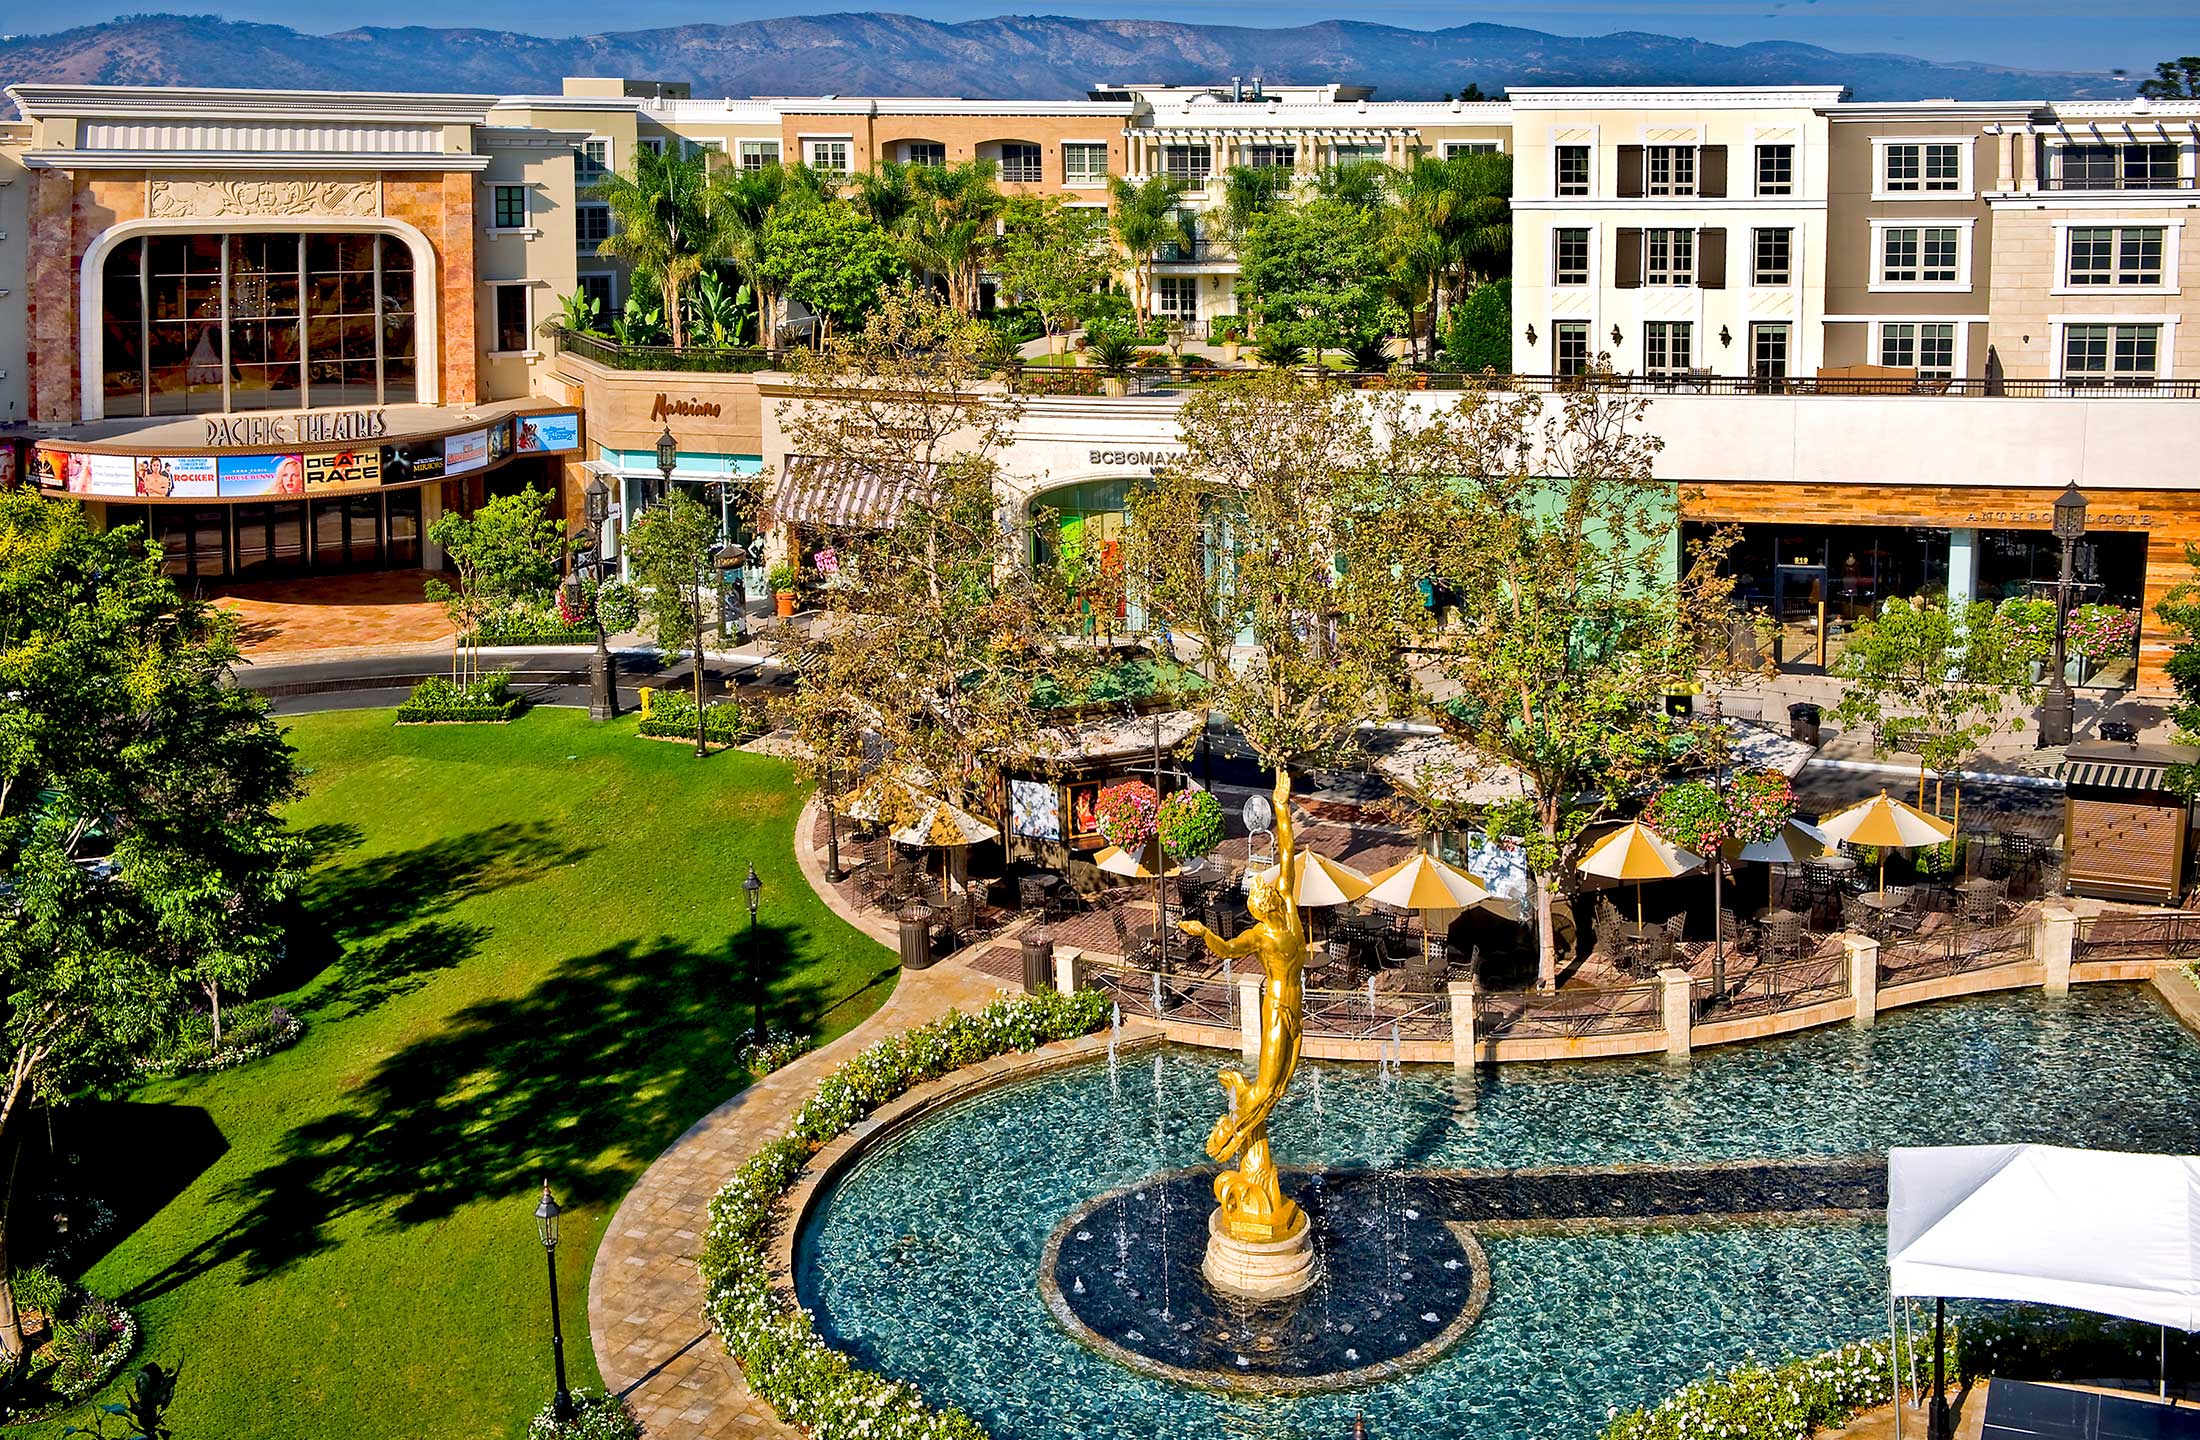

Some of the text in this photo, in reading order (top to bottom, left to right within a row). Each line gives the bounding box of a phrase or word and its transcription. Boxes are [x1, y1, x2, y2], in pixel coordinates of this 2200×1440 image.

[650, 393, 721, 423] Marciano
[205, 408, 387, 446] PACIFIC THEATRES
[306, 453, 379, 469] DEATH
[413, 461, 444, 472] MIRRORS
[173, 473, 215, 482] ROCKER
[306, 466, 379, 484] RACE
[1965, 511, 2154, 526] ANTHROLOGIE
